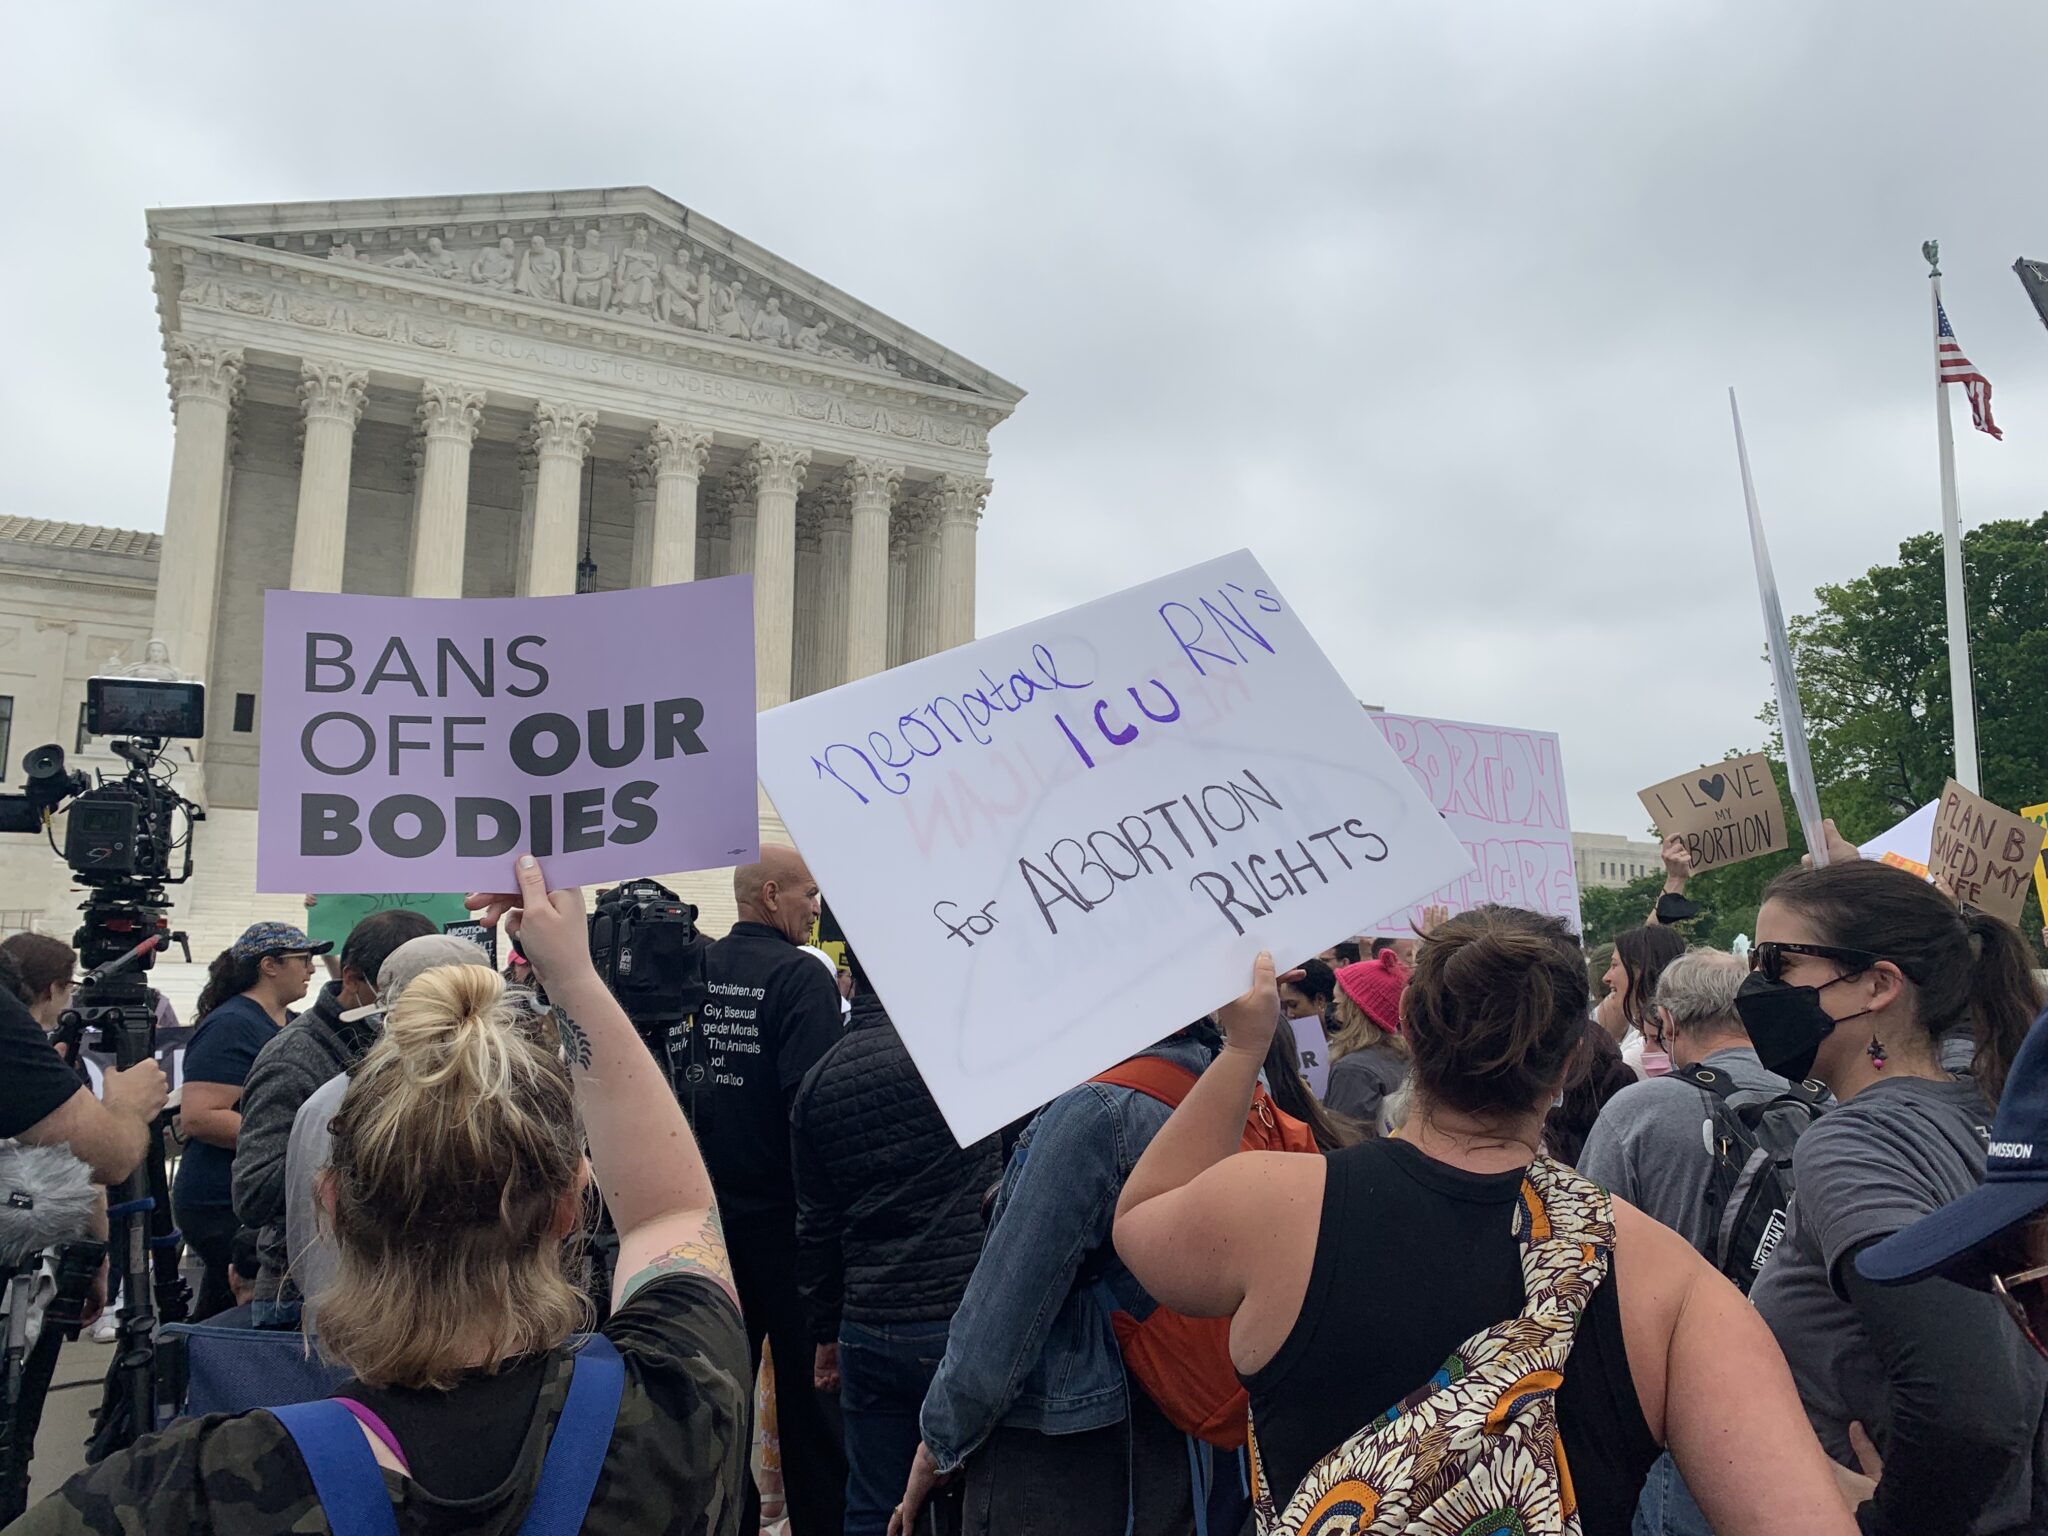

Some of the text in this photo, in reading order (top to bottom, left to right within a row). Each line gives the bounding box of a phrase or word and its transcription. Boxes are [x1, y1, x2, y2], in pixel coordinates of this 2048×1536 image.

[473, 335, 780, 408] EQUAL JUSTICE UNDER LAW
[305, 632, 549, 698] BANS
[301, 697, 709, 777] OFF OUR
[1054, 679, 1181, 768] ICU
[1370, 716, 1565, 829] BORTION
[1656, 793, 1673, 818] I
[301, 780, 660, 859] BODIES
[1714, 807, 1732, 821] MY
[1943, 792, 1998, 850] PLAN
[2002, 827, 2026, 863] B
[933, 900, 1001, 947] for
[1018, 769, 1284, 936] ABORTION
[1190, 818, 1389, 937] RIGHTS
[1935, 826, 2031, 899] SAVED MY
[724, 1006, 757, 1020] Bisexual
[727, 1040, 761, 1054] Animals
[730, 1023, 759, 1037] Morals
